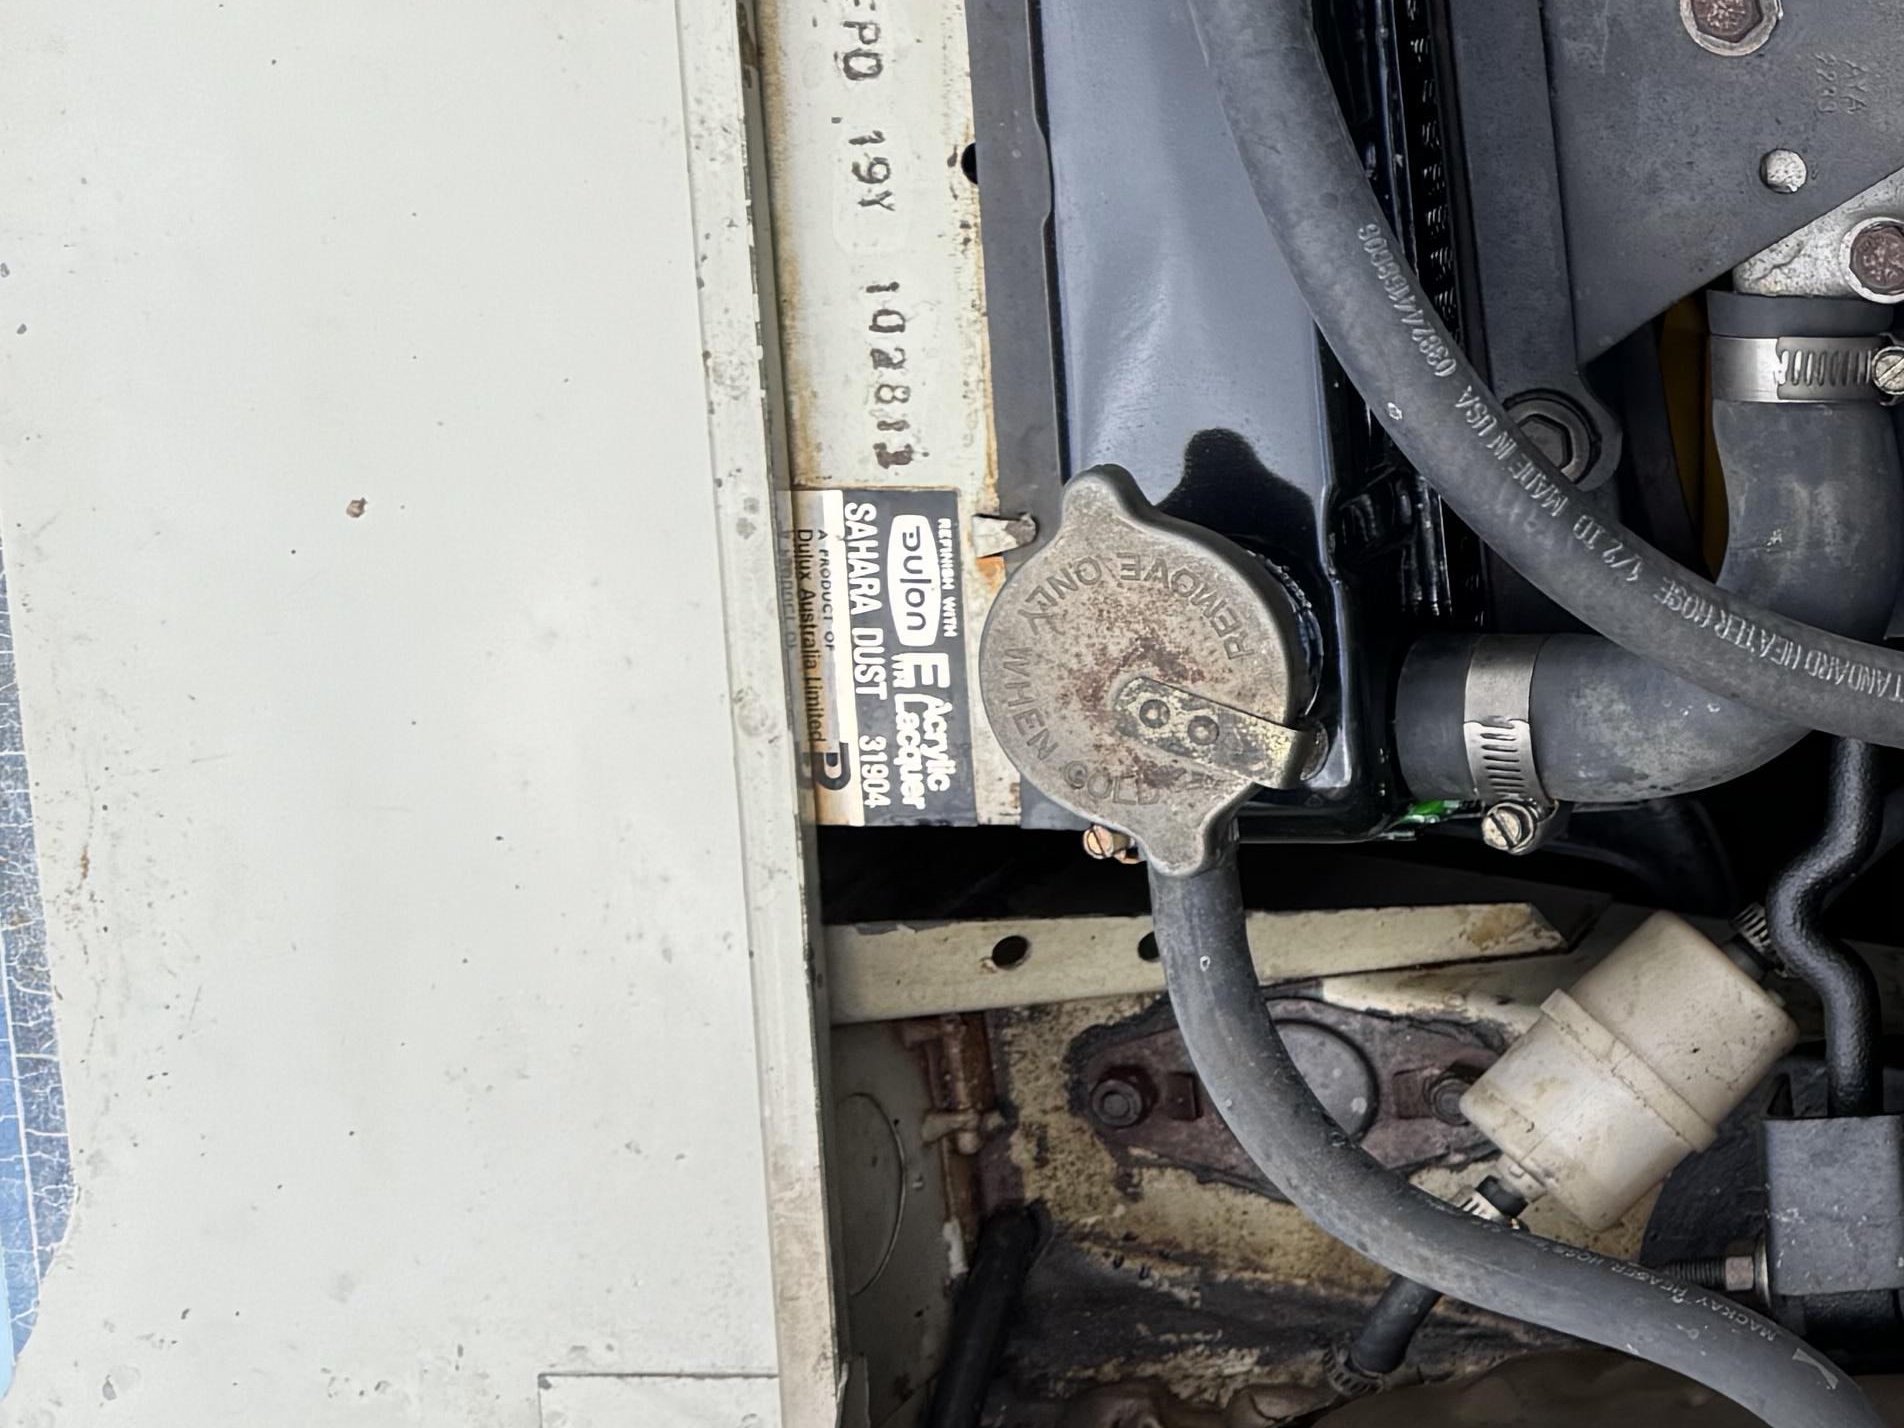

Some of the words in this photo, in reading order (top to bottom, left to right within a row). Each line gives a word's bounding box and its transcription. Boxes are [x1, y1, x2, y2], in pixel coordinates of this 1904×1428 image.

[1454, 385, 1498, 438] USA
[1487, 438, 1517, 462] IN
[1506, 457, 1569, 518] MADE
[794, 528, 816, 582] Dulux
[817, 528, 830, 541] A
[844, 502, 883, 615] SAHARA
[937, 517, 956, 590] REFINISH
[818, 548, 834, 623] PRODUCT
[899, 525, 932, 631] Dulon
[1017, 555, 1103, 637] ONLY
[1117, 554, 1255, 662] REMOVE
[1652, 575, 1713, 629] HOSE
[798, 588, 823, 669] Australia
[823, 630, 836, 652] OF
[941, 595, 958, 638] WITH
[1713, 608, 1802, 670] HEATER
[851, 627, 888, 701] DUST
[803, 676, 827, 743] Limited
[1002, 645, 1058, 762] WHEN
[858, 735, 892, 808] 31904
[893, 692, 928, 810] Lacquer
[920, 695, 957, 792] Acrylic
[1062, 759, 1160, 807] COLD
[1694, 1295, 1778, 1342] MACKAY
